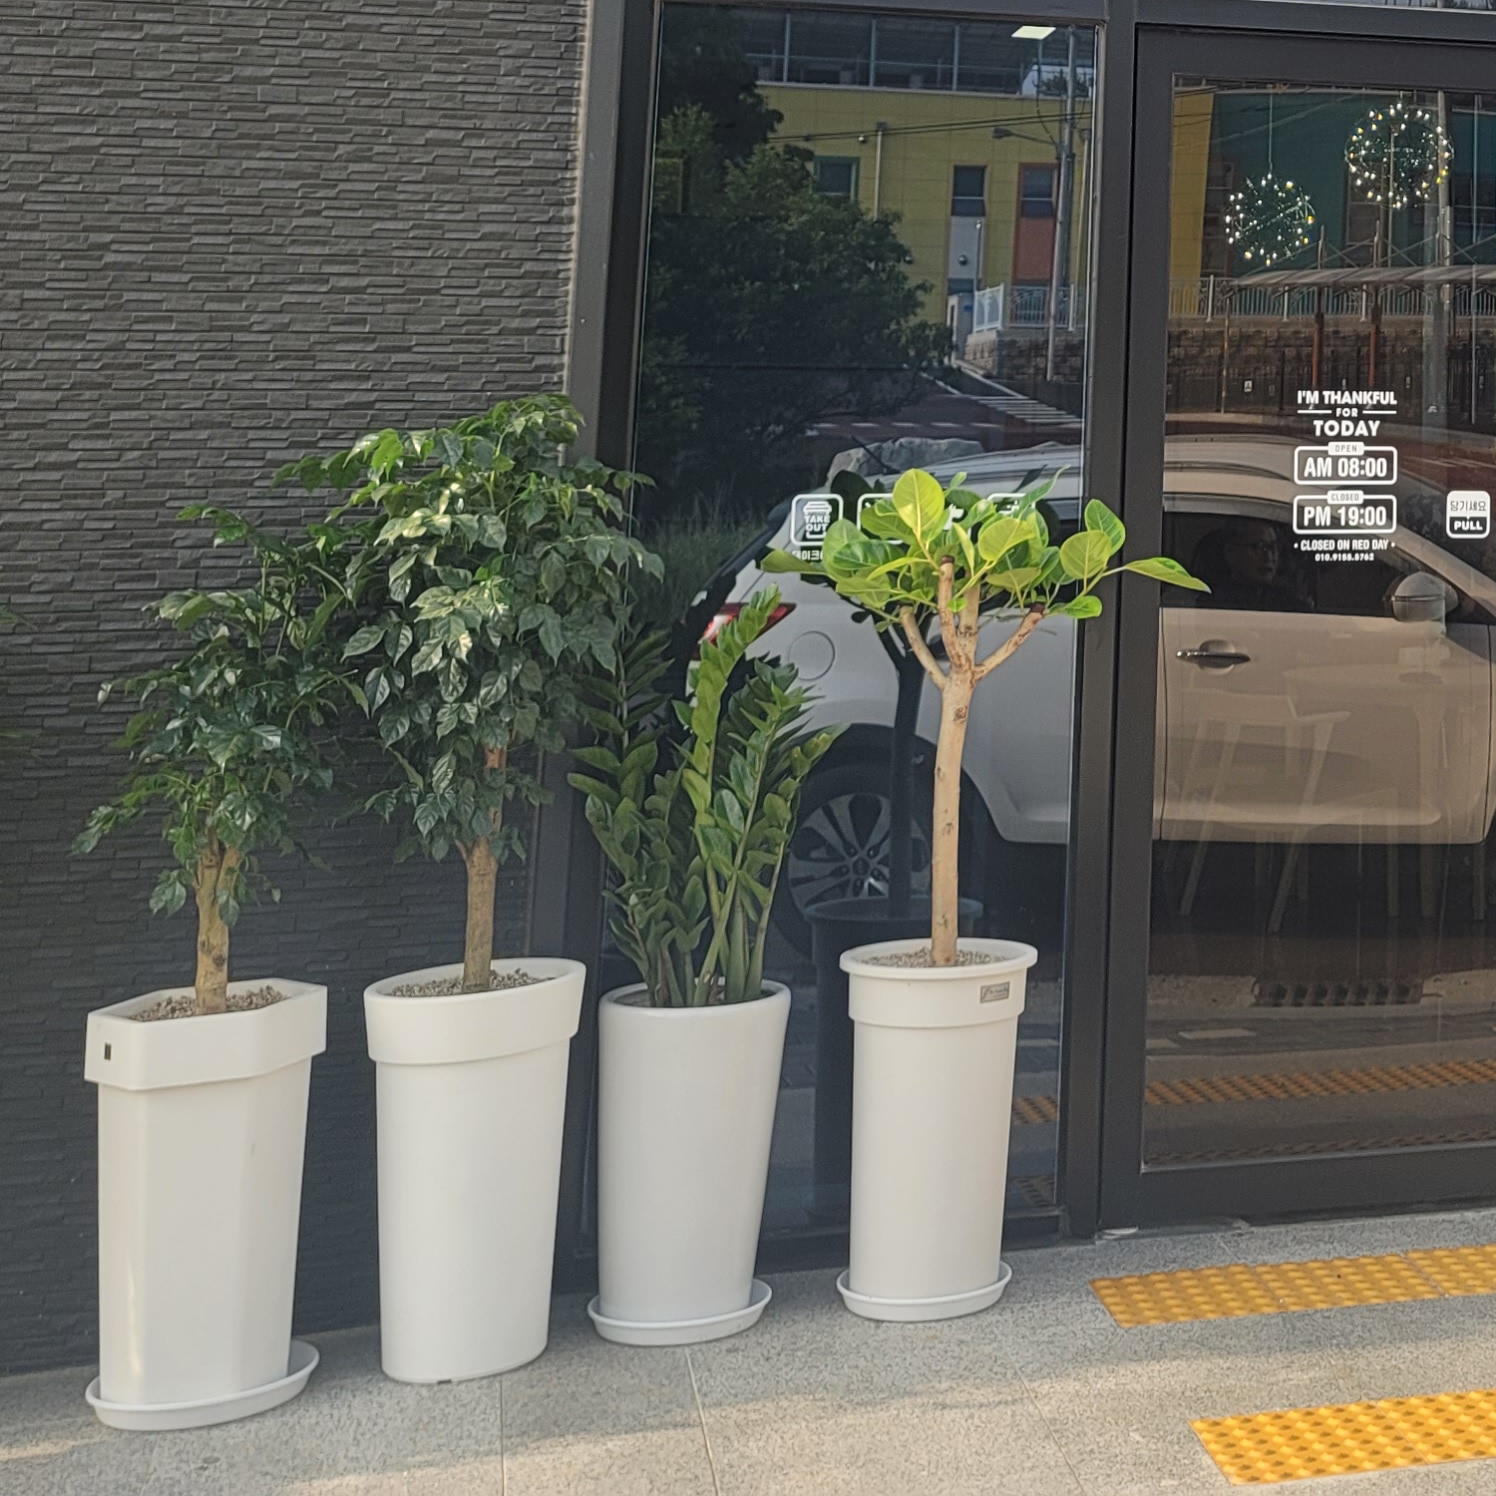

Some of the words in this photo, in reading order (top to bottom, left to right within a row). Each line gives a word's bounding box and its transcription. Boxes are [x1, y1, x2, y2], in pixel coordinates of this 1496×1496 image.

[1297, 390, 1319, 404] I'M
[1322, 390, 1398, 405] THANKFUL
[1336, 407, 1358, 417] FOR
[1313, 419, 1380, 437] TODAY
[1304, 457, 1332, 477] AM
[1338, 457, 1387, 477] 08:00
[1331, 493, 1359, 501] CLOSED
[1450, 500, 1487, 511] 당기세요
[804, 515, 830, 523] TAKE
[1304, 506, 1331, 526] PM
[1337, 506, 1387, 526] 19:00
[805, 523, 827, 531] OUT
[1454, 520, 1483, 531] PULL
[1300, 539, 1335, 551] CLOSED
[1337, 539, 1350, 550] ON
[1352, 539, 1370, 550] RED
[1371, 539, 1389, 550] DAY
